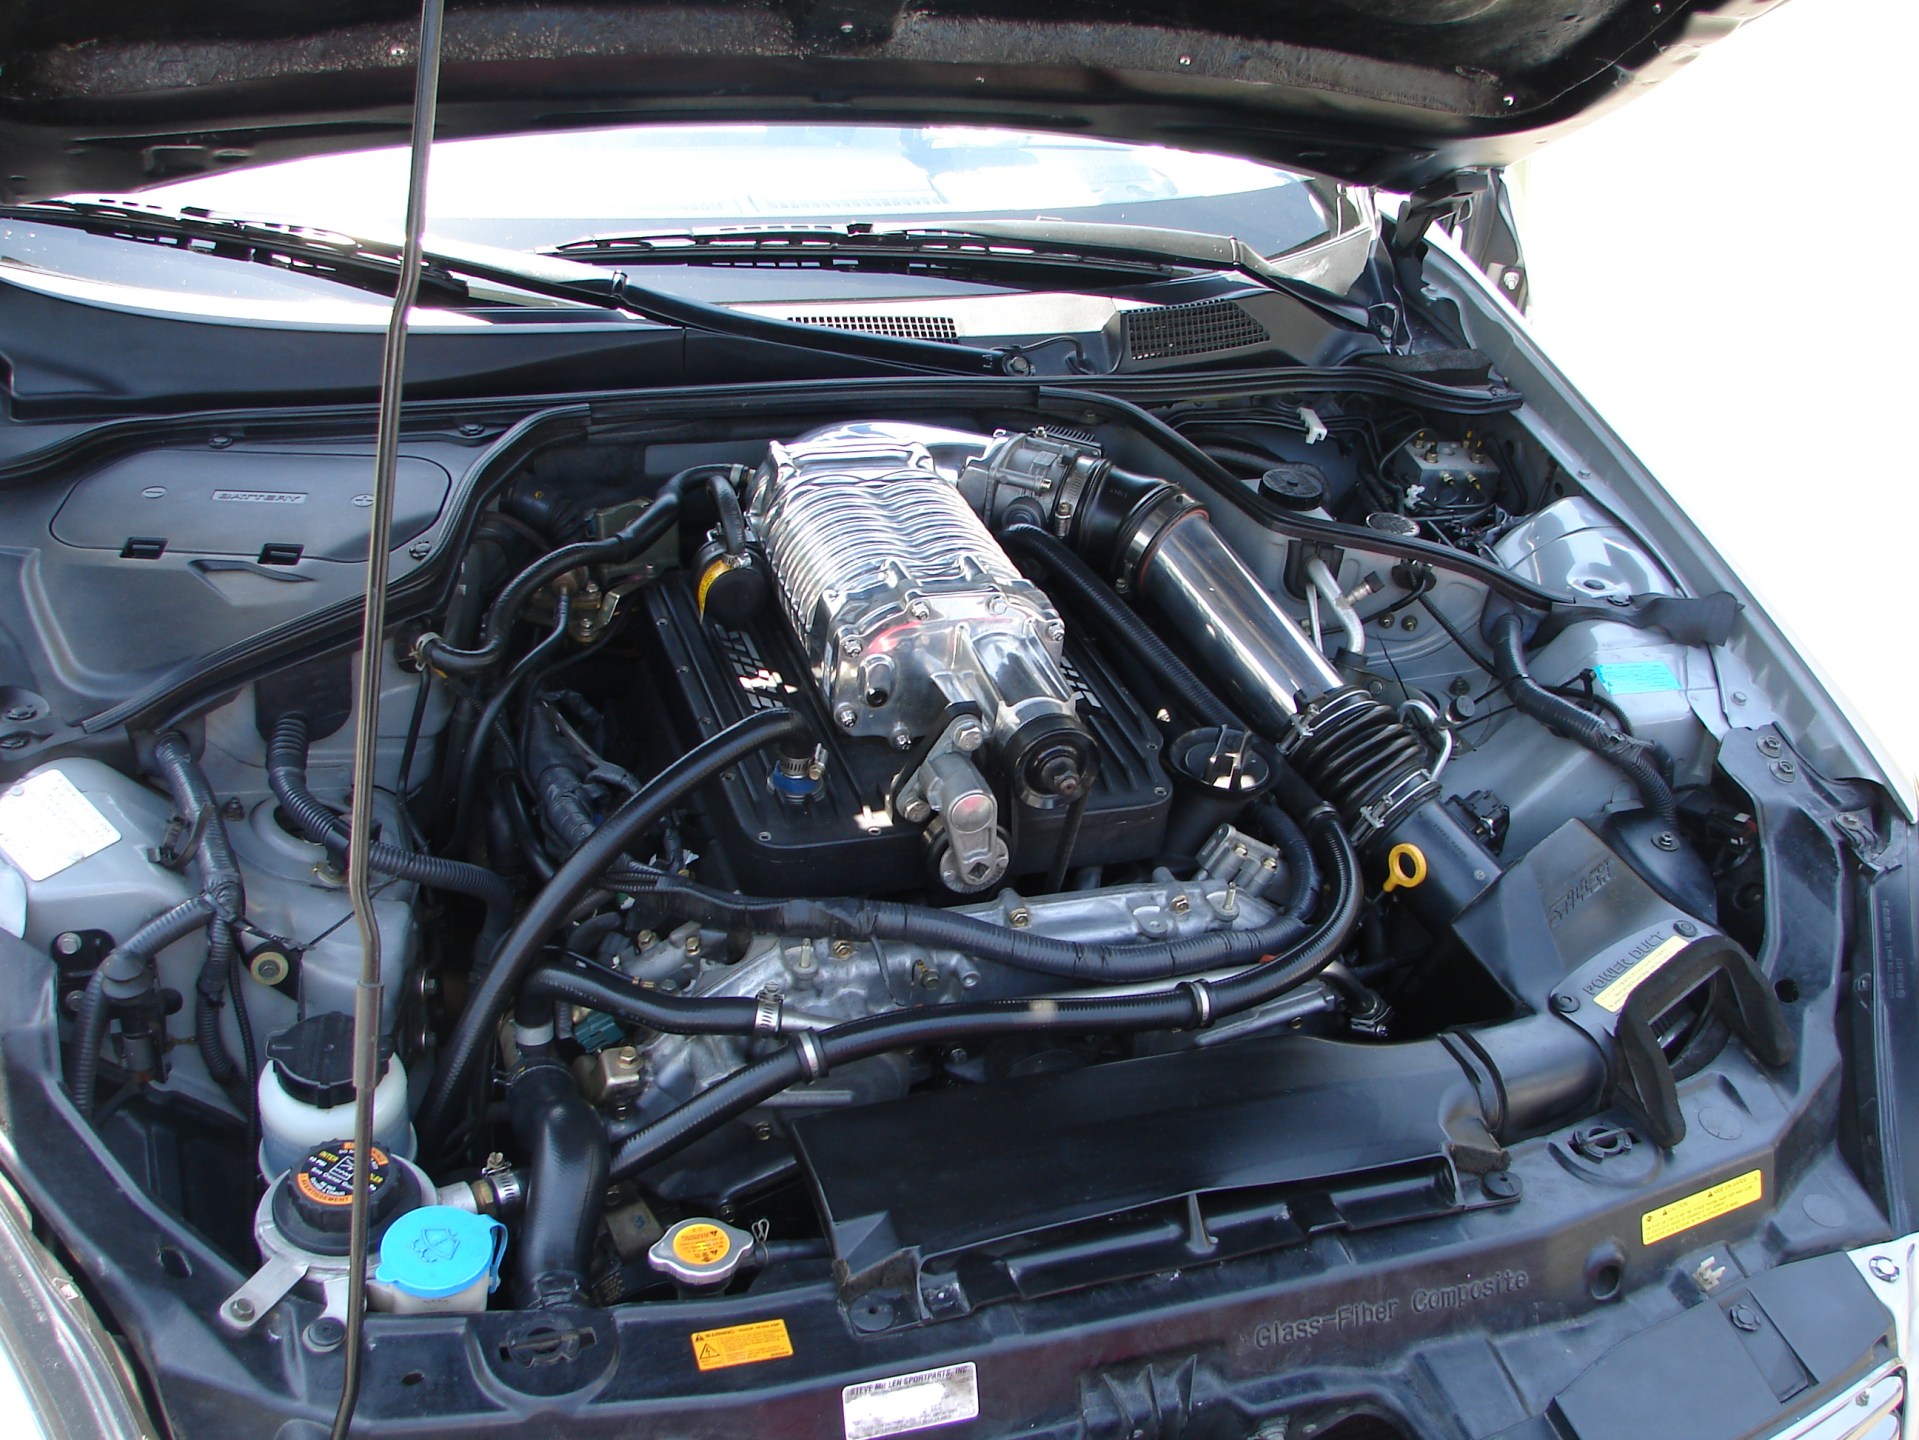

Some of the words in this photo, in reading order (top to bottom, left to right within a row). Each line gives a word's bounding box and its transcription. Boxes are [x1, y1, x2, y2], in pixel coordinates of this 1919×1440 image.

[219, 493, 301, 502] BATTERY
[1582, 958, 1632, 996] POWER
[1628, 931, 1666, 960] DUCT
[319, 1150, 339, 1162] INTER
[1254, 1299, 1400, 1349] Glass-Fiber
[1411, 1268, 1530, 1313] Composite
[850, 1384, 873, 1396] STEVE
